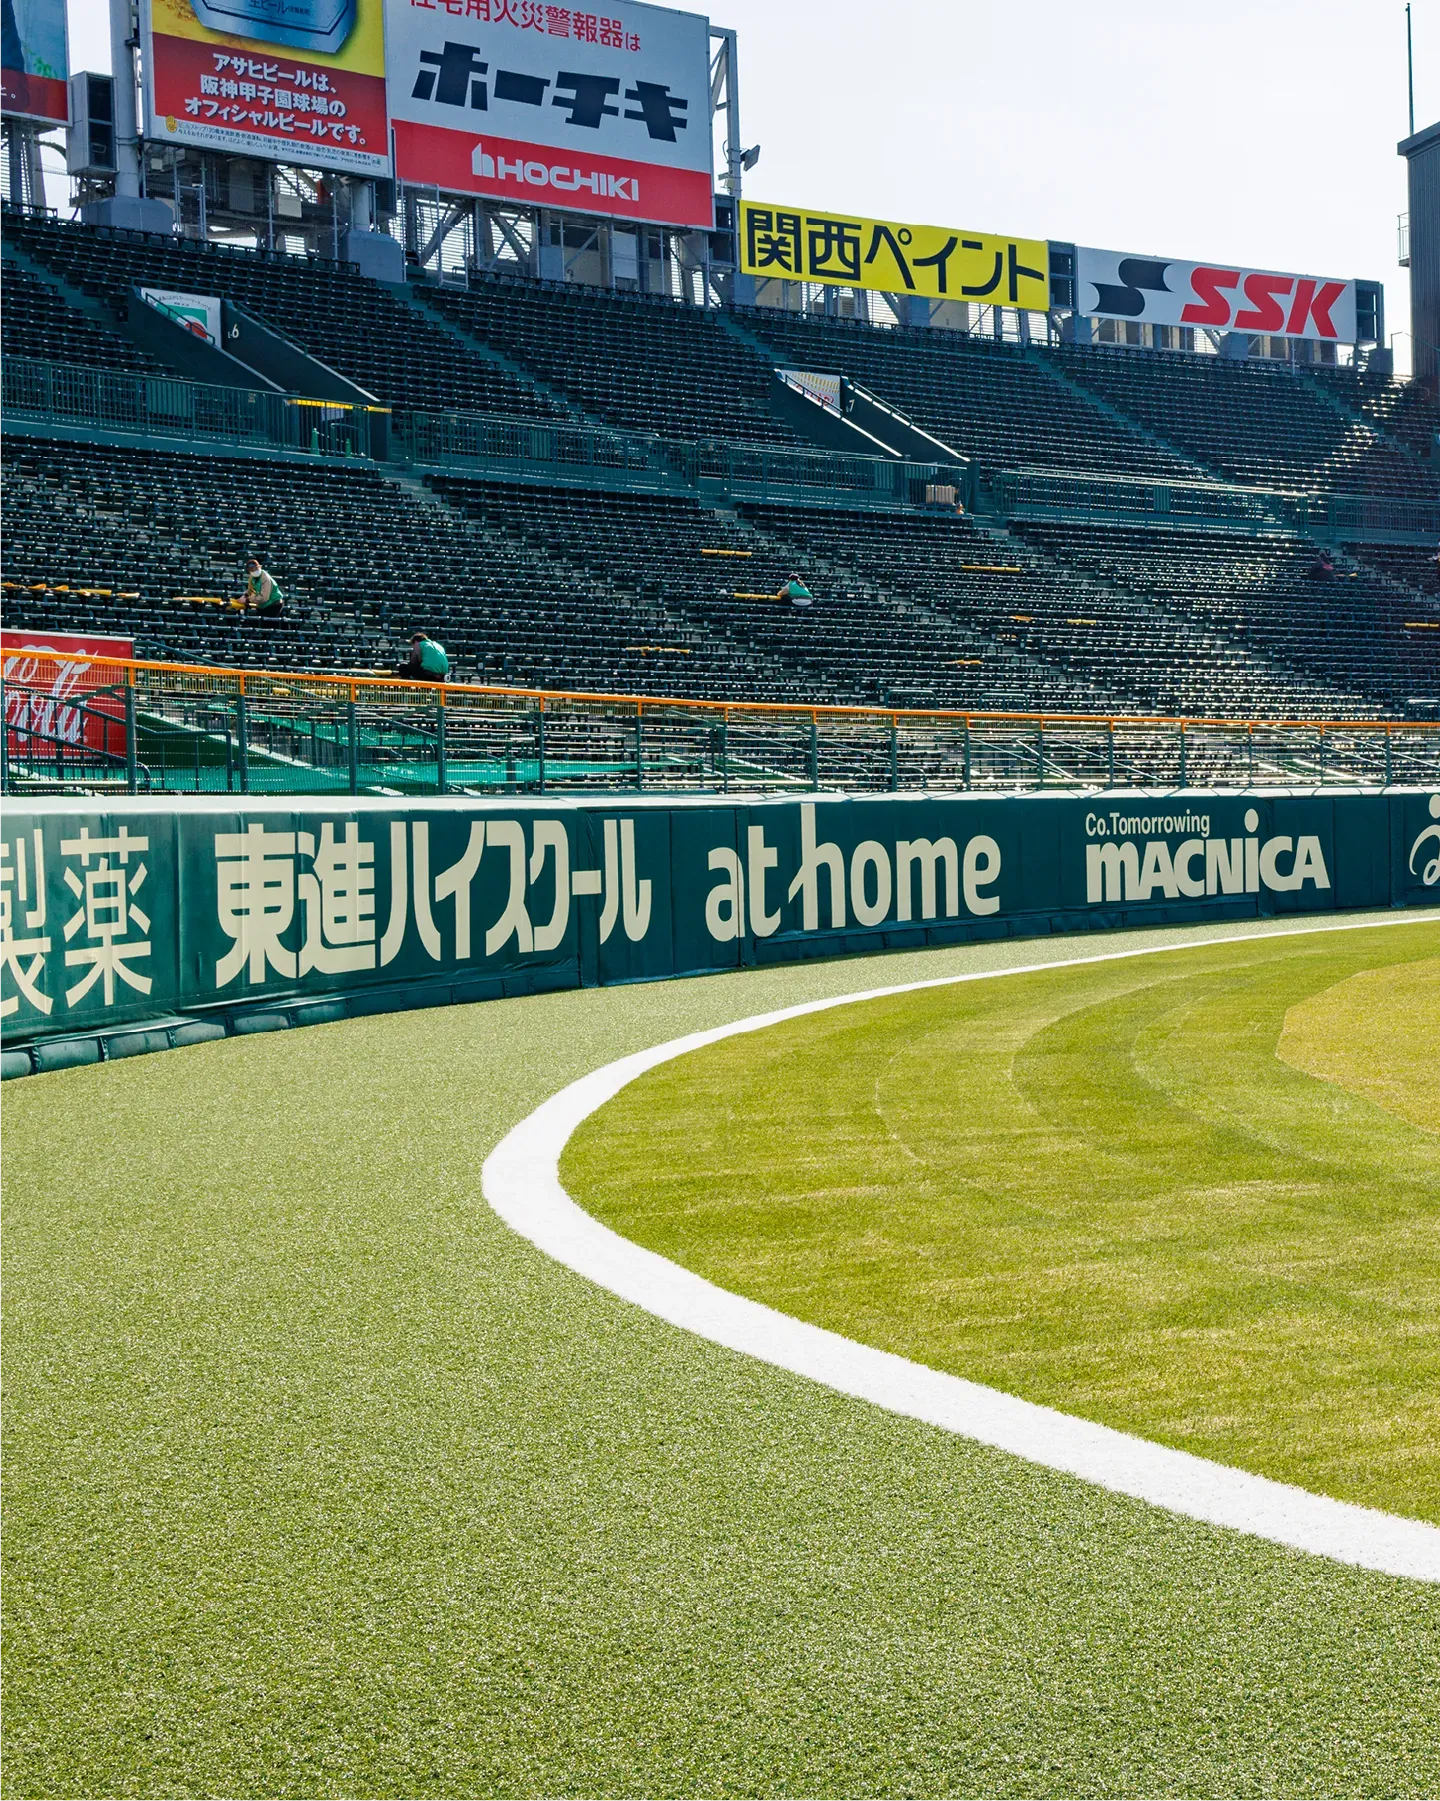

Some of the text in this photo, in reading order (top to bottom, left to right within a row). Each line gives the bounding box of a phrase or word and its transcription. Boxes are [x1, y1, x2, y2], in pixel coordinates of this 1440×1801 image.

[200, 73, 346, 117] 阪神甲子園球場の
[212, 52, 337, 94] アサヒビールは、
[411, 40, 688, 143] ホーチキ
[184, 96, 366, 146] オフィシャルビールです。
[497, 155, 639, 201] HOCHIKI
[746, 208, 1045, 304] 関西ペイント
[1181, 266, 1346, 338] SSK
[1085, 809, 1211, 838] Co.Tomorrowing
[214, 818, 652, 989] 東進ハイスクール
